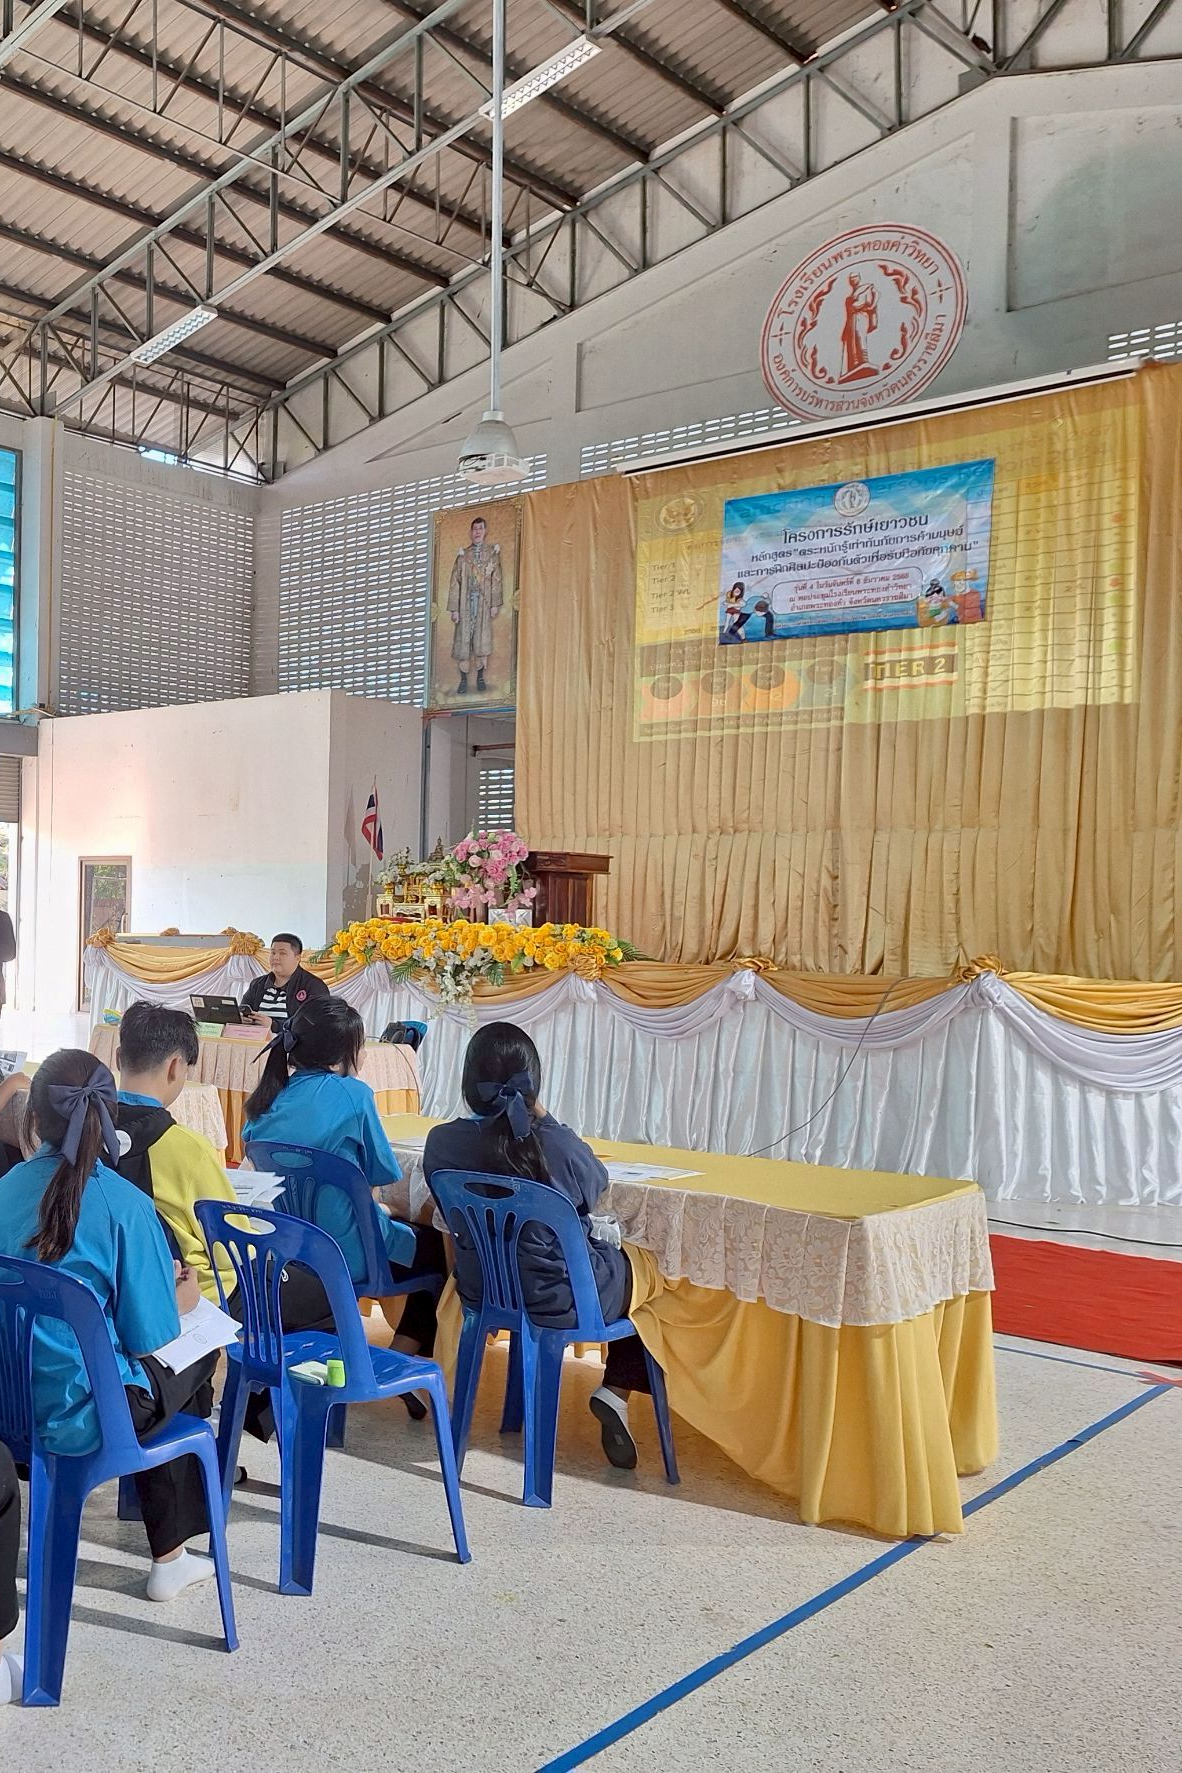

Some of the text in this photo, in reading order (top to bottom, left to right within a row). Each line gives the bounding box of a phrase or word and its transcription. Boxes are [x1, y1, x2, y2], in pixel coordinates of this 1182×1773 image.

[777, 235, 939, 319] โรงเรียนพระทองคำวิทยา
[773, 313, 947, 412] องค์การบริหารส่วนจังหวัดนครราชสีมา
[782, 513, 929, 545] โครงการรักษ์เยาวชน
[870, 657, 946, 679] TIER 2
